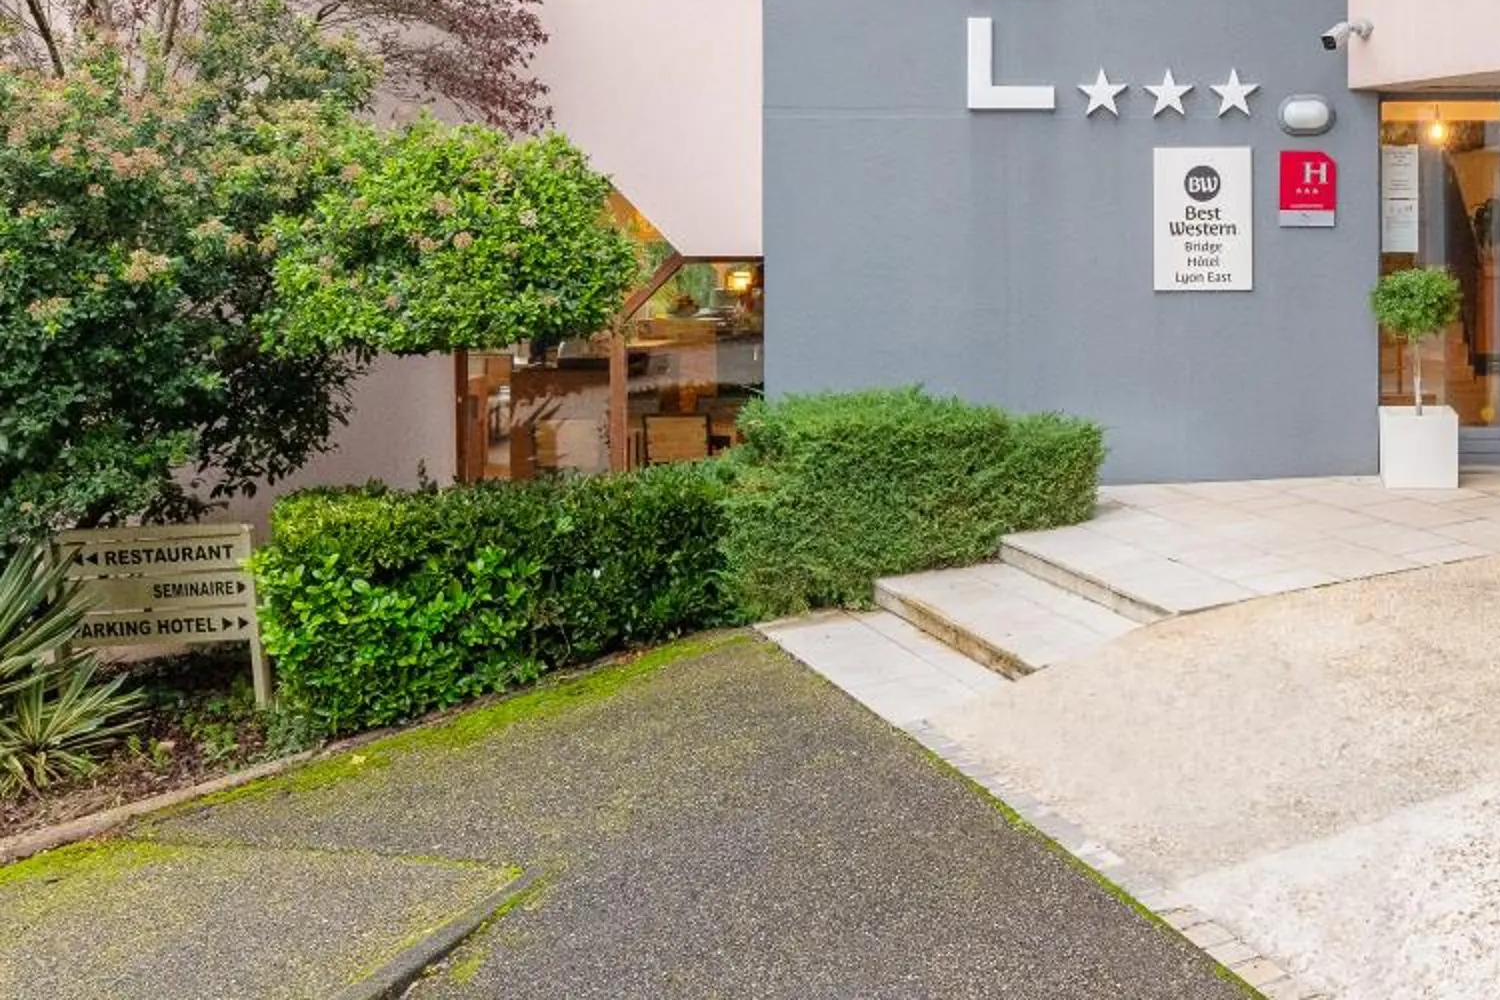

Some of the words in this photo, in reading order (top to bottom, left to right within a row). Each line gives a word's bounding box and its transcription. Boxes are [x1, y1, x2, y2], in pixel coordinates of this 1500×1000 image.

[1302, 161, 1329, 185] H
[1188, 176, 1219, 194] BW
[1184, 205, 1222, 221] Best
[1168, 221, 1237, 236] Western
[1184, 241, 1222, 254] Bridge
[1175, 271, 1204, 284] Lyon
[1207, 271, 1232, 283] East
[104, 544, 235, 566] RESTAURANT
[152, 581, 234, 599] SEMINAIRE
[157, 617, 217, 634] HOTEL
